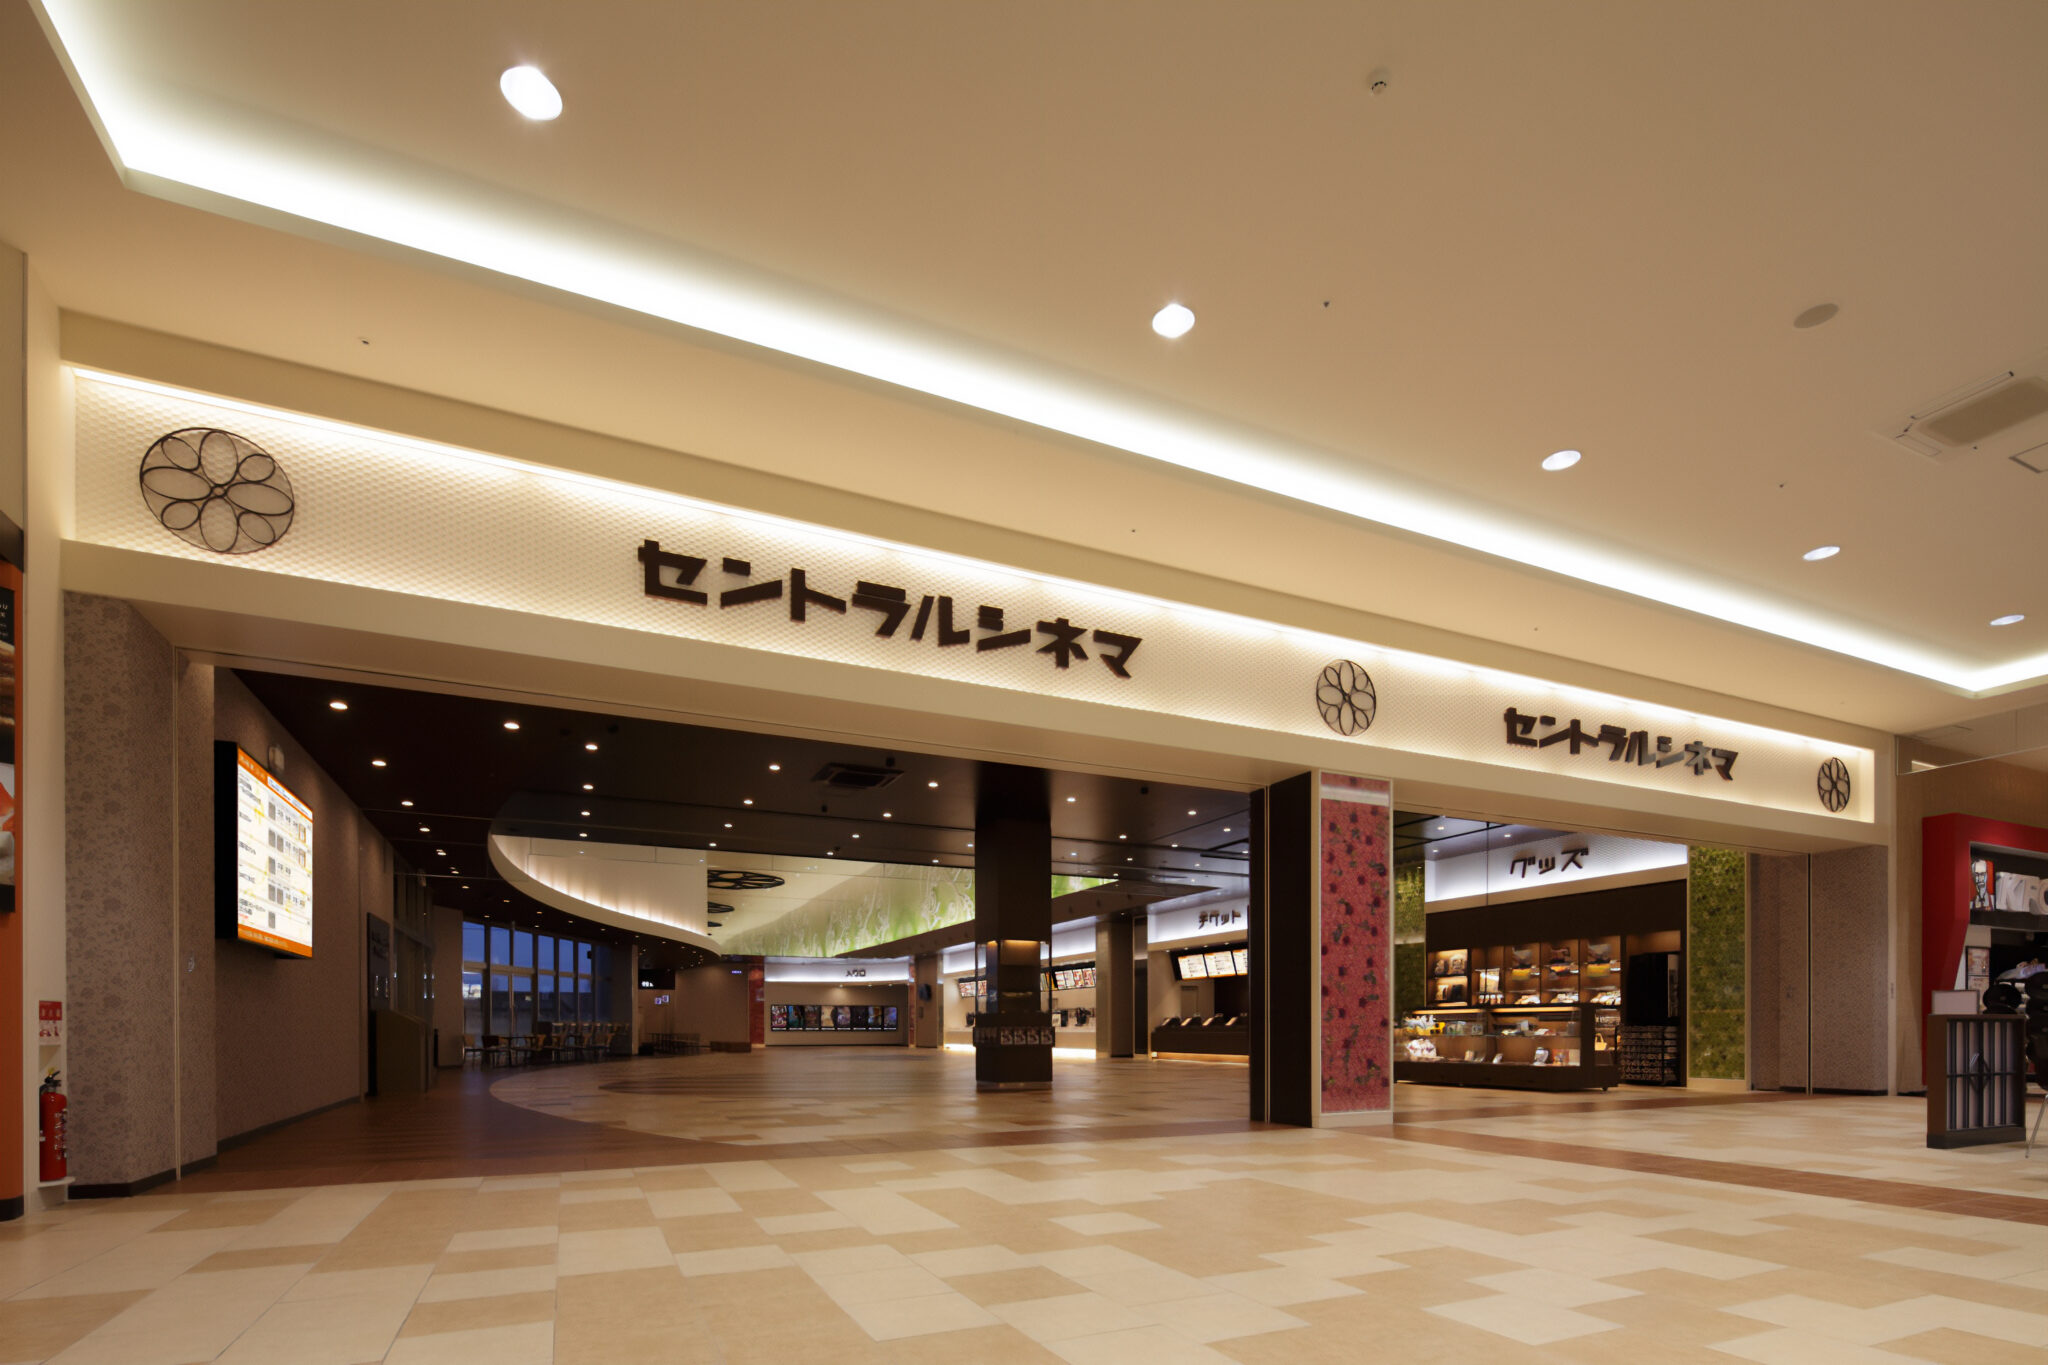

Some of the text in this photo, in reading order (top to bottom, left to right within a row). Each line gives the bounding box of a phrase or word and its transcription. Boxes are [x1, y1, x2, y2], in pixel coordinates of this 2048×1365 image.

[638, 540, 1143, 678] セントラルシネマ
[1504, 707, 1738, 781] セントラルシネマ
[1509, 847, 1589, 878] グッズ
[1198, 909, 1241, 930] チケット
